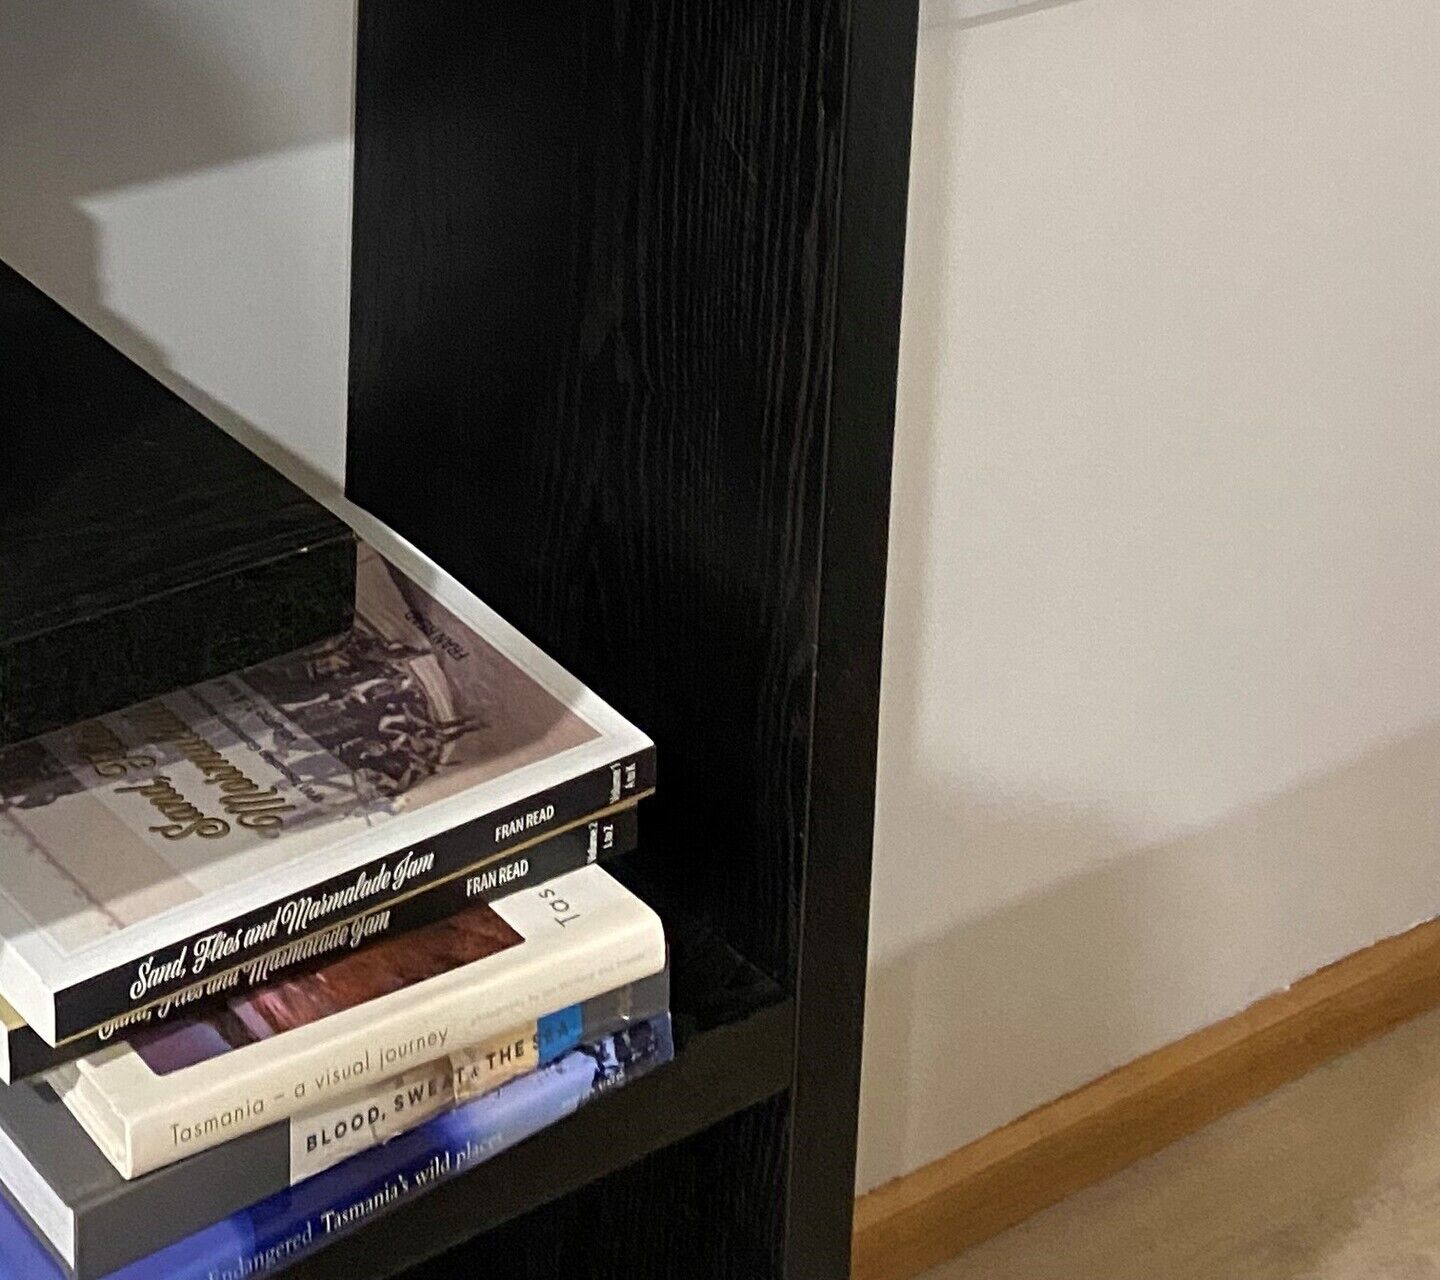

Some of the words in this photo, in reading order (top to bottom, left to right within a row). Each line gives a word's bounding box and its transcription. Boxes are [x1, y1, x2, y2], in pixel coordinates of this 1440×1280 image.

[495, 814, 525, 844] FRAN
[526, 804, 555, 832] READ
[129, 954, 187, 1000] Sand,
[192, 927, 241, 974] Flies
[243, 912, 278, 946] and
[282, 866, 392, 936] Marmalade
[391, 850, 435, 891] Jam
[467, 871, 498, 898] FRAN
[499, 859, 529, 888] READ
[170, 1096, 265, 1146] Tasmania
[294, 1080, 306, 1099] a
[310, 1057, 369, 1091] visual
[378, 1026, 450, 1072] journey
[305, 1105, 387, 1153] BLOOD,
[393, 1066, 465, 1113] SWEAT
[485, 1038, 525, 1070] THE
[320, 1175, 409, 1233] Tasmania's
[416, 1152, 451, 1186] wild
